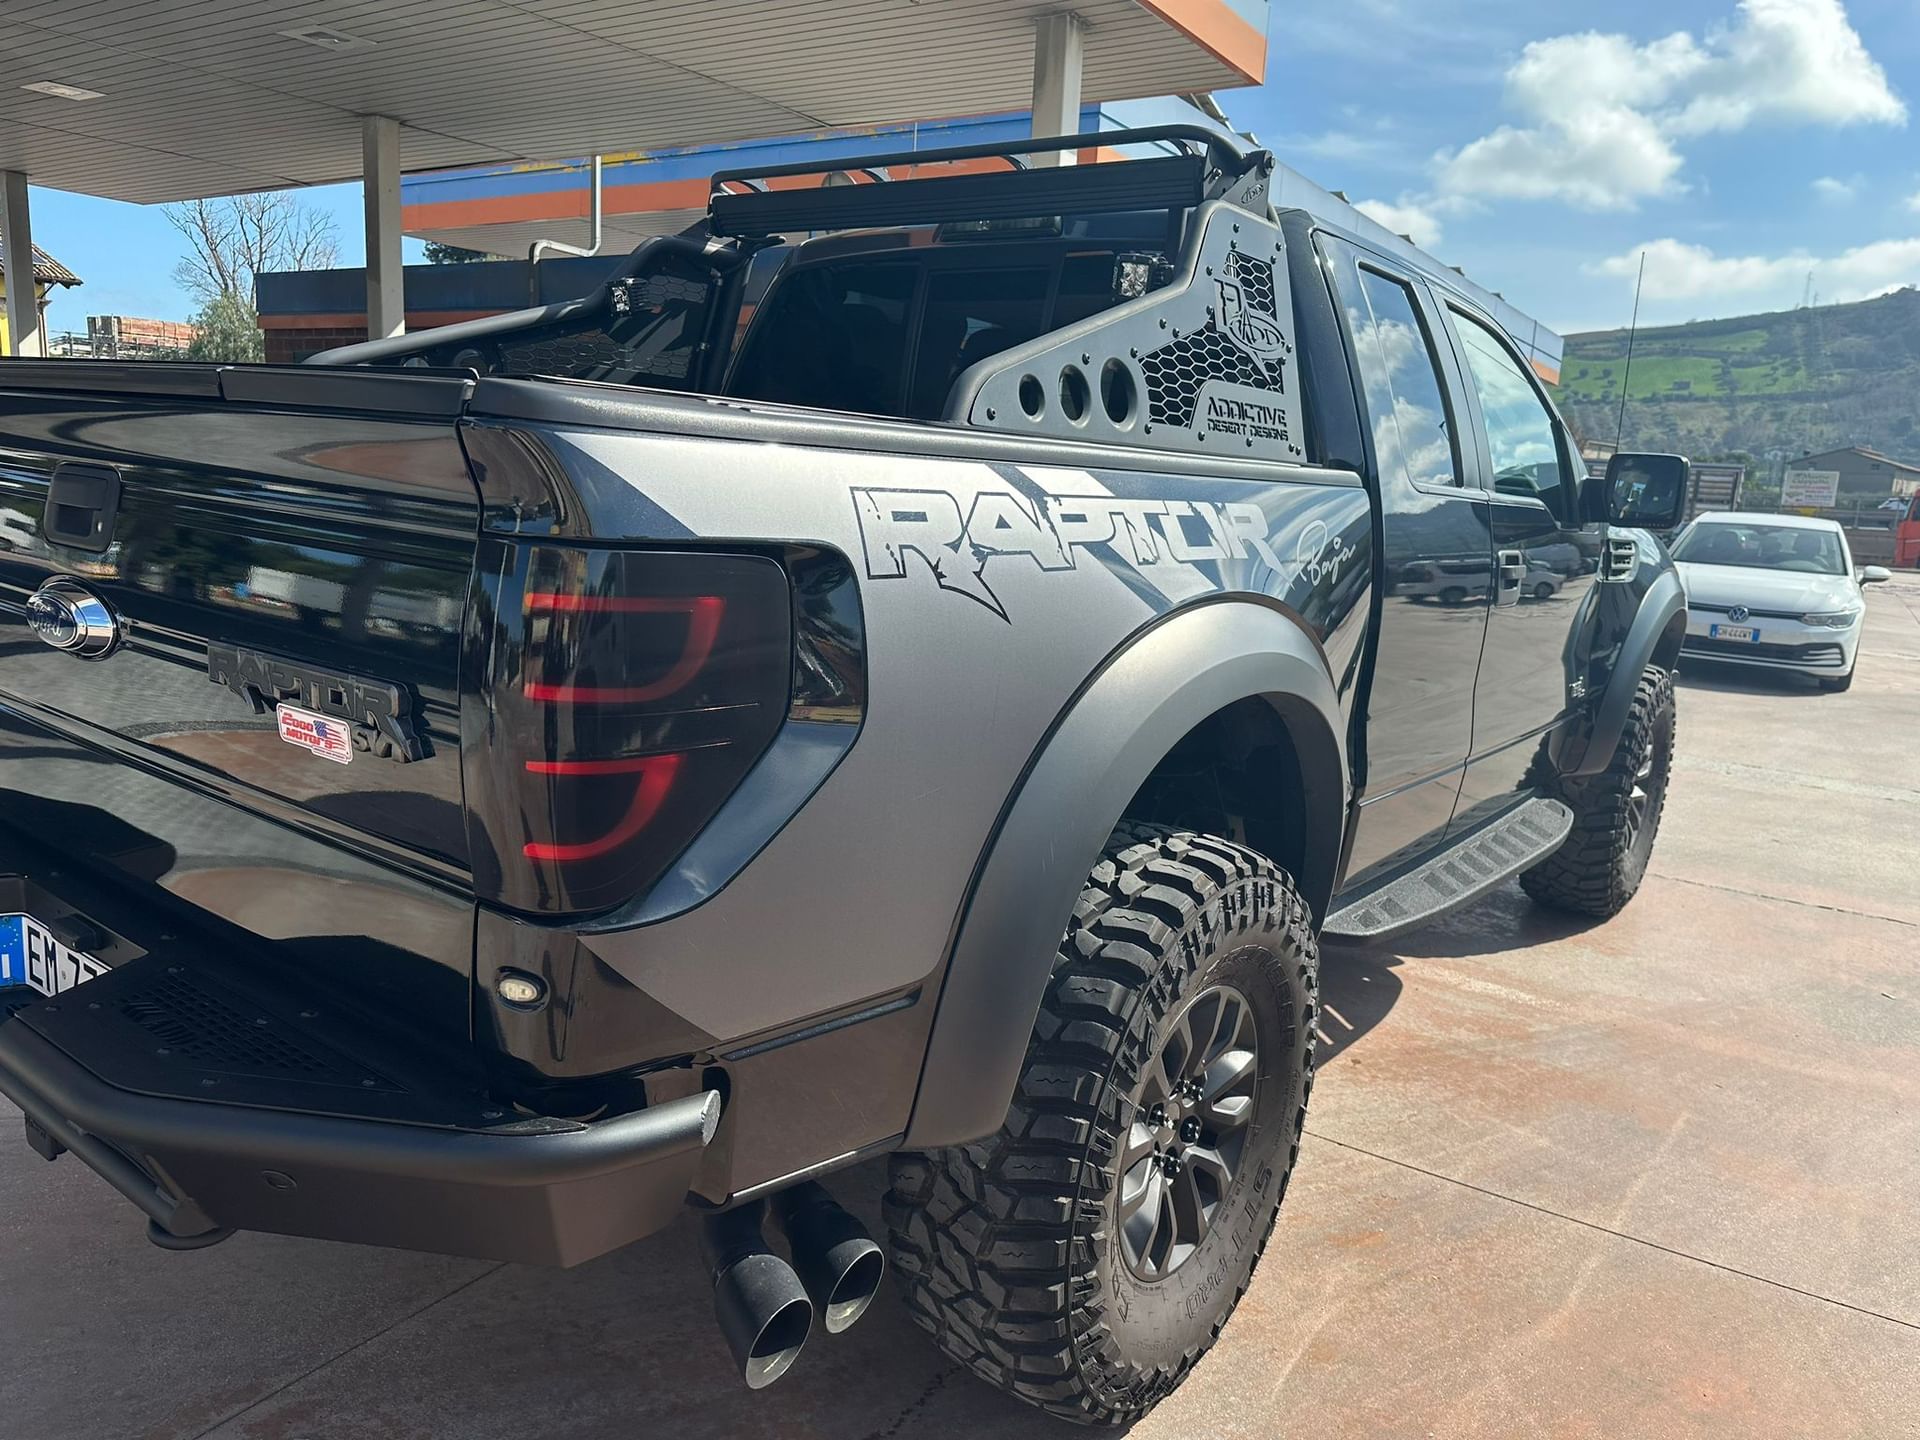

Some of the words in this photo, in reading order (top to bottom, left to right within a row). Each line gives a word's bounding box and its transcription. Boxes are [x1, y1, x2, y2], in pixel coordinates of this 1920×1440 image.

[1207, 396, 1288, 427] ADDICTIVE
[1207, 418, 1247, 436] DESERT
[1249, 424, 1289, 441] DESIGNS
[849, 486, 1295, 625] RAPTOR
[207, 639, 414, 763] RAPTOR
[281, 711, 314, 732] 2000
[28, 925, 58, 993] EM
